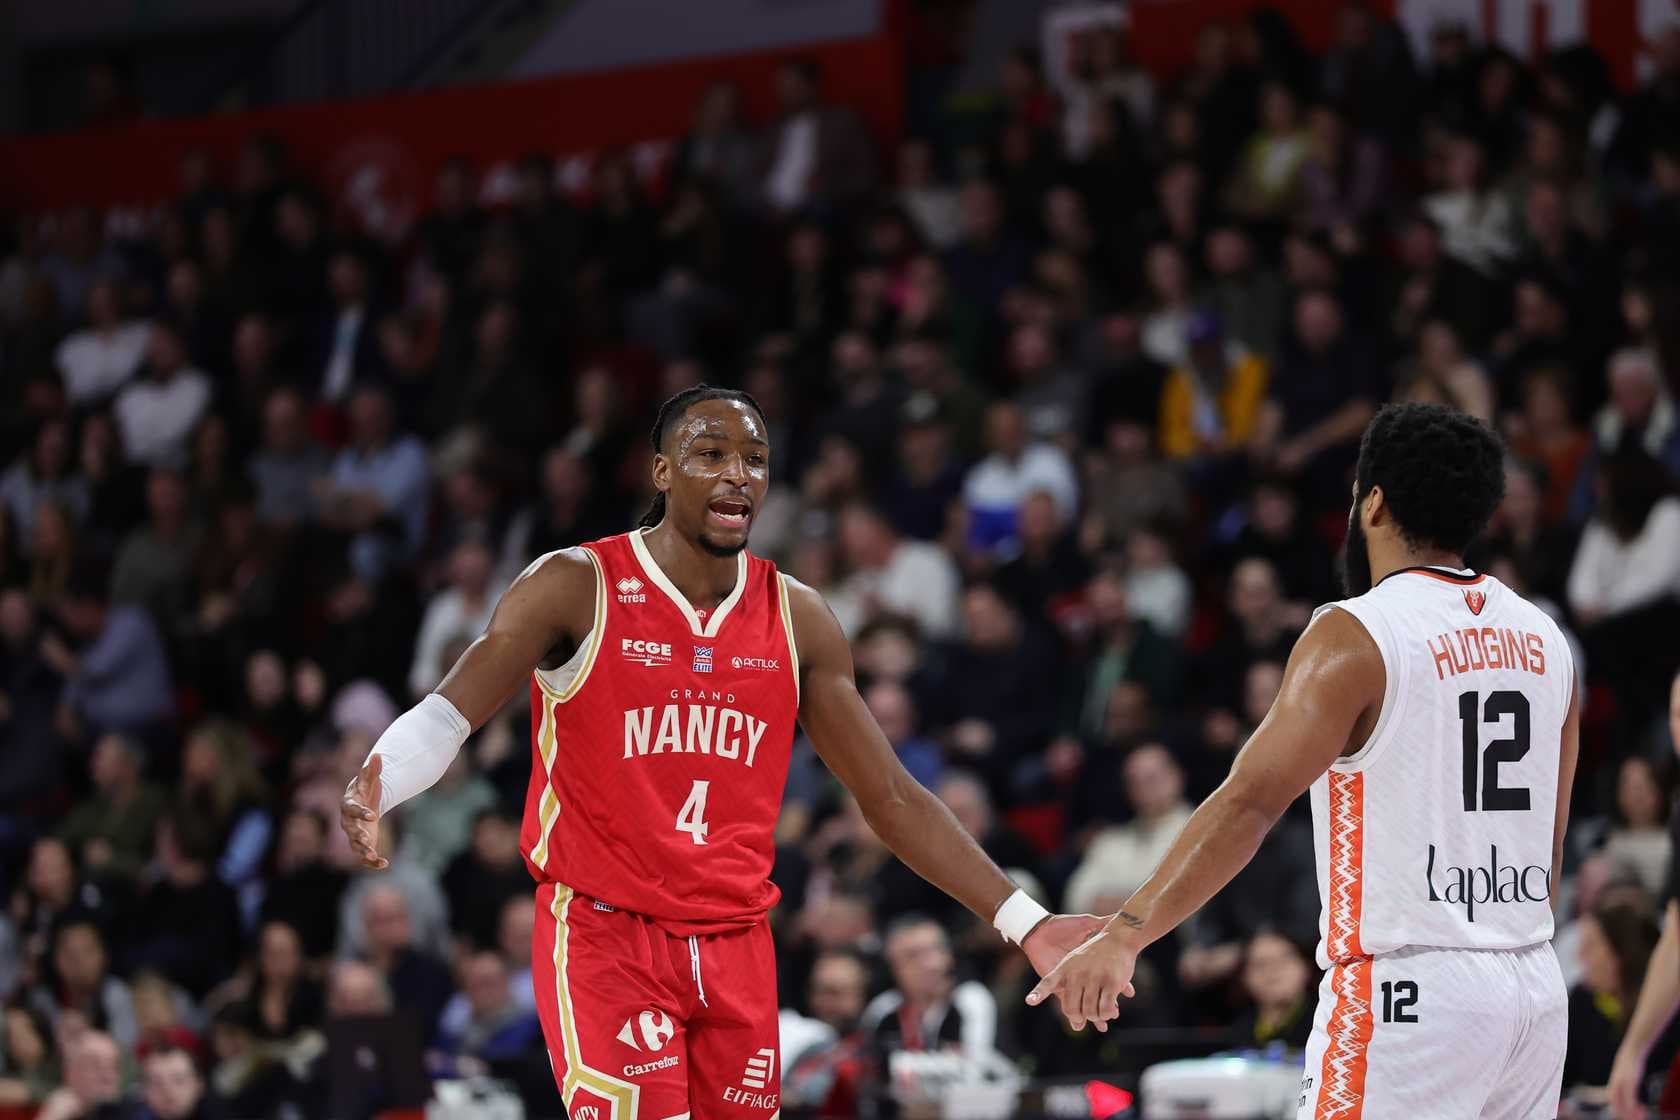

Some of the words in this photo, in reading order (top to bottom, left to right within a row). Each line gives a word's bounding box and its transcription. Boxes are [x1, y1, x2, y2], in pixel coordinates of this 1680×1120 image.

[622, 638, 672, 656] FCGE
[743, 657, 779, 669] ACTILOC
[1426, 627, 1545, 680] HUDGINS
[670, 689, 735, 703] GRAND
[623, 704, 768, 768] NANCY
[1458, 690, 1531, 812] 12
[675, 780, 710, 845] 4
[1426, 844, 1551, 923] Laplac
[1381, 980, 1419, 1023] 12
[623, 1056, 679, 1077] Carrefour
